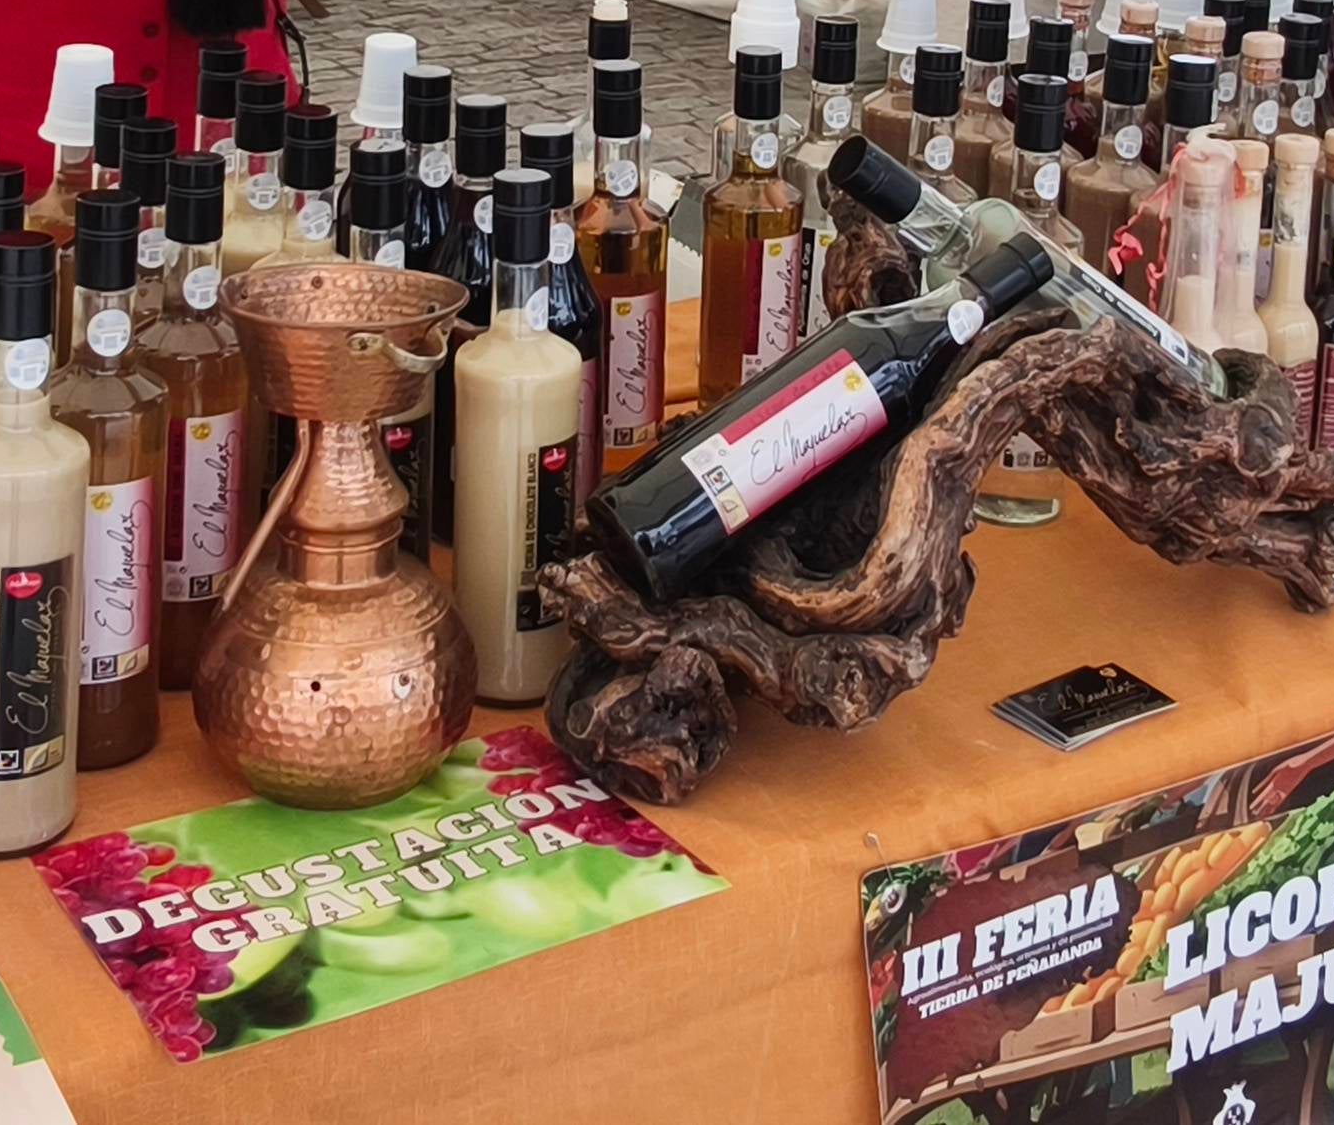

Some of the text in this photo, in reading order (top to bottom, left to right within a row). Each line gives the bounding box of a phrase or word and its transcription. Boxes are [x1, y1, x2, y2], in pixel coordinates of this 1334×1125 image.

[82, 778, 611, 945] DEGUSTACIÓN
[192, 822, 585, 953] GRATUITA
[902, 873, 1119, 996] III FERIA
[916, 935, 1103, 1019] TIERRA DE PEÑARANDA
